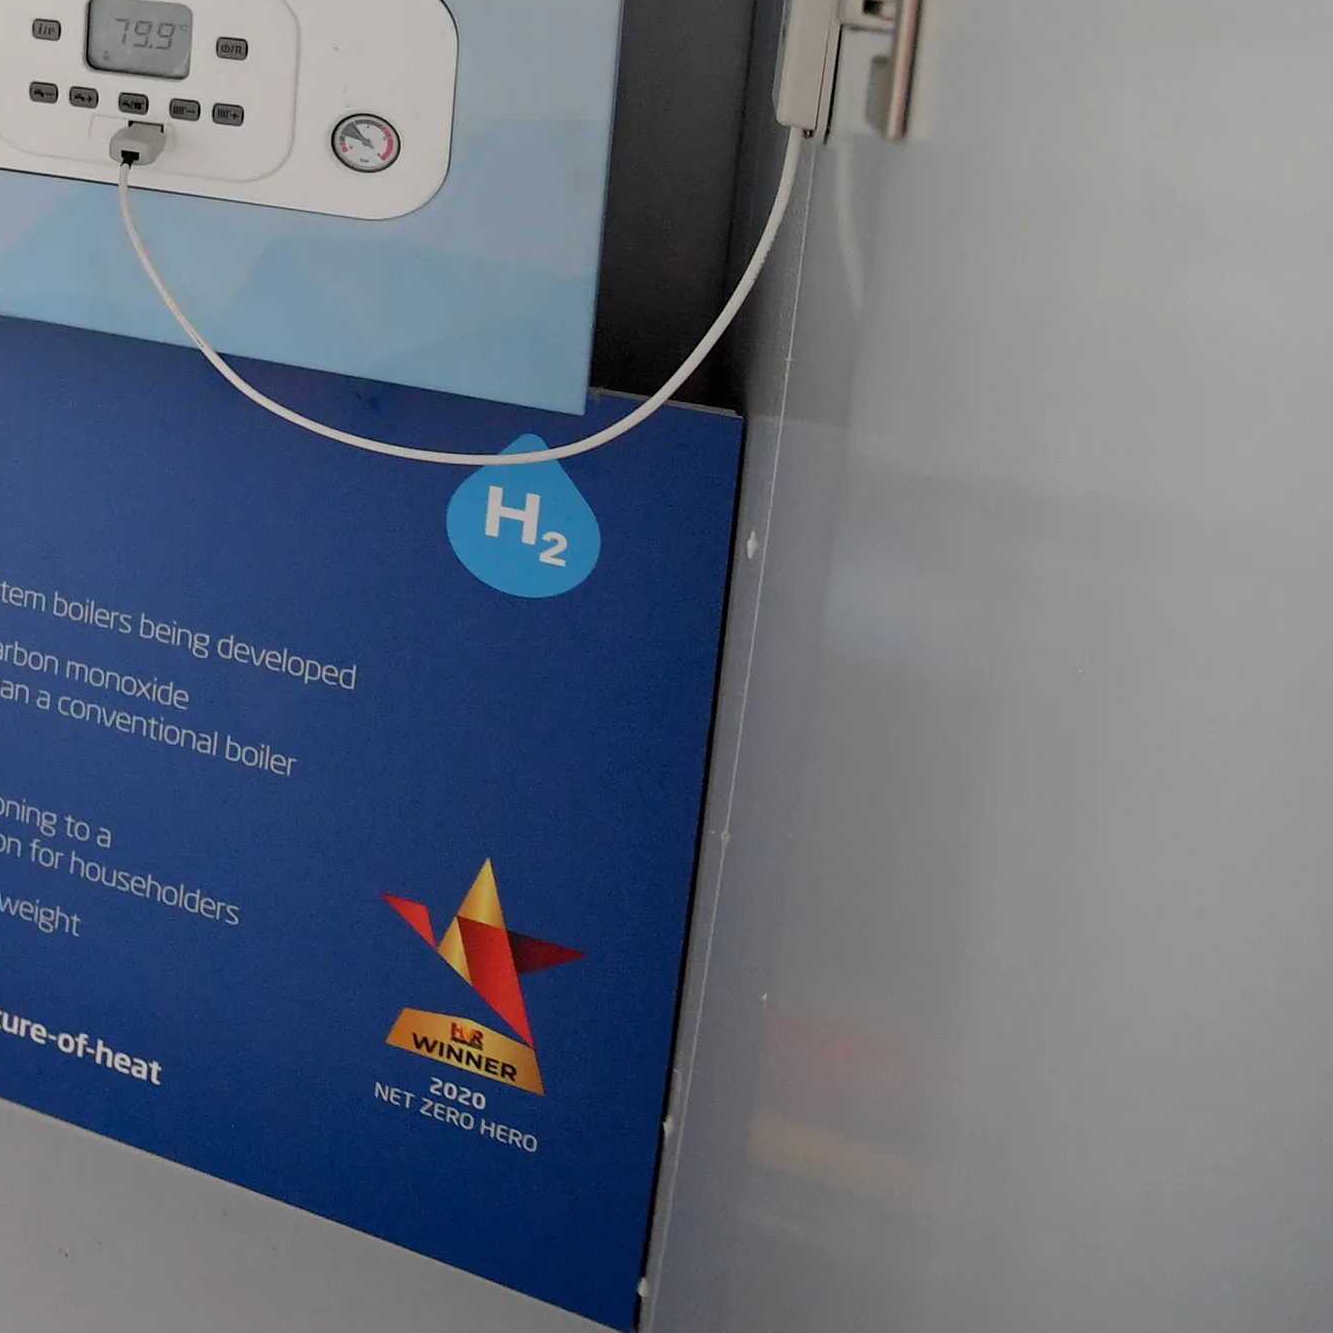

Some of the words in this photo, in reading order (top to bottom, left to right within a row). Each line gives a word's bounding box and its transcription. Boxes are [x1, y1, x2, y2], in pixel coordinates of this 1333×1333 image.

[114, 17, 177, 51] 79.9
[52, 591, 133, 634] boilers
[139, 612, 211, 659] being
[216, 634, 357, 691] developed
[65, 660, 190, 711] monoxide
[35, 689, 51, 711] a
[57, 695, 219, 757] conventional
[224, 734, 298, 777] boiler
[64, 814, 91, 842] to
[96, 827, 112, 849] a
[29, 838, 65, 870] for
[69, 850, 240, 926] householders
[411, 1032, 517, 1081] WINNER
[374, 1081, 416, 1109] NET
[419, 1097, 475, 1131] ZERO
[479, 1118, 538, 1153] HERO
[429, 1077, 487, 1110] 2020
